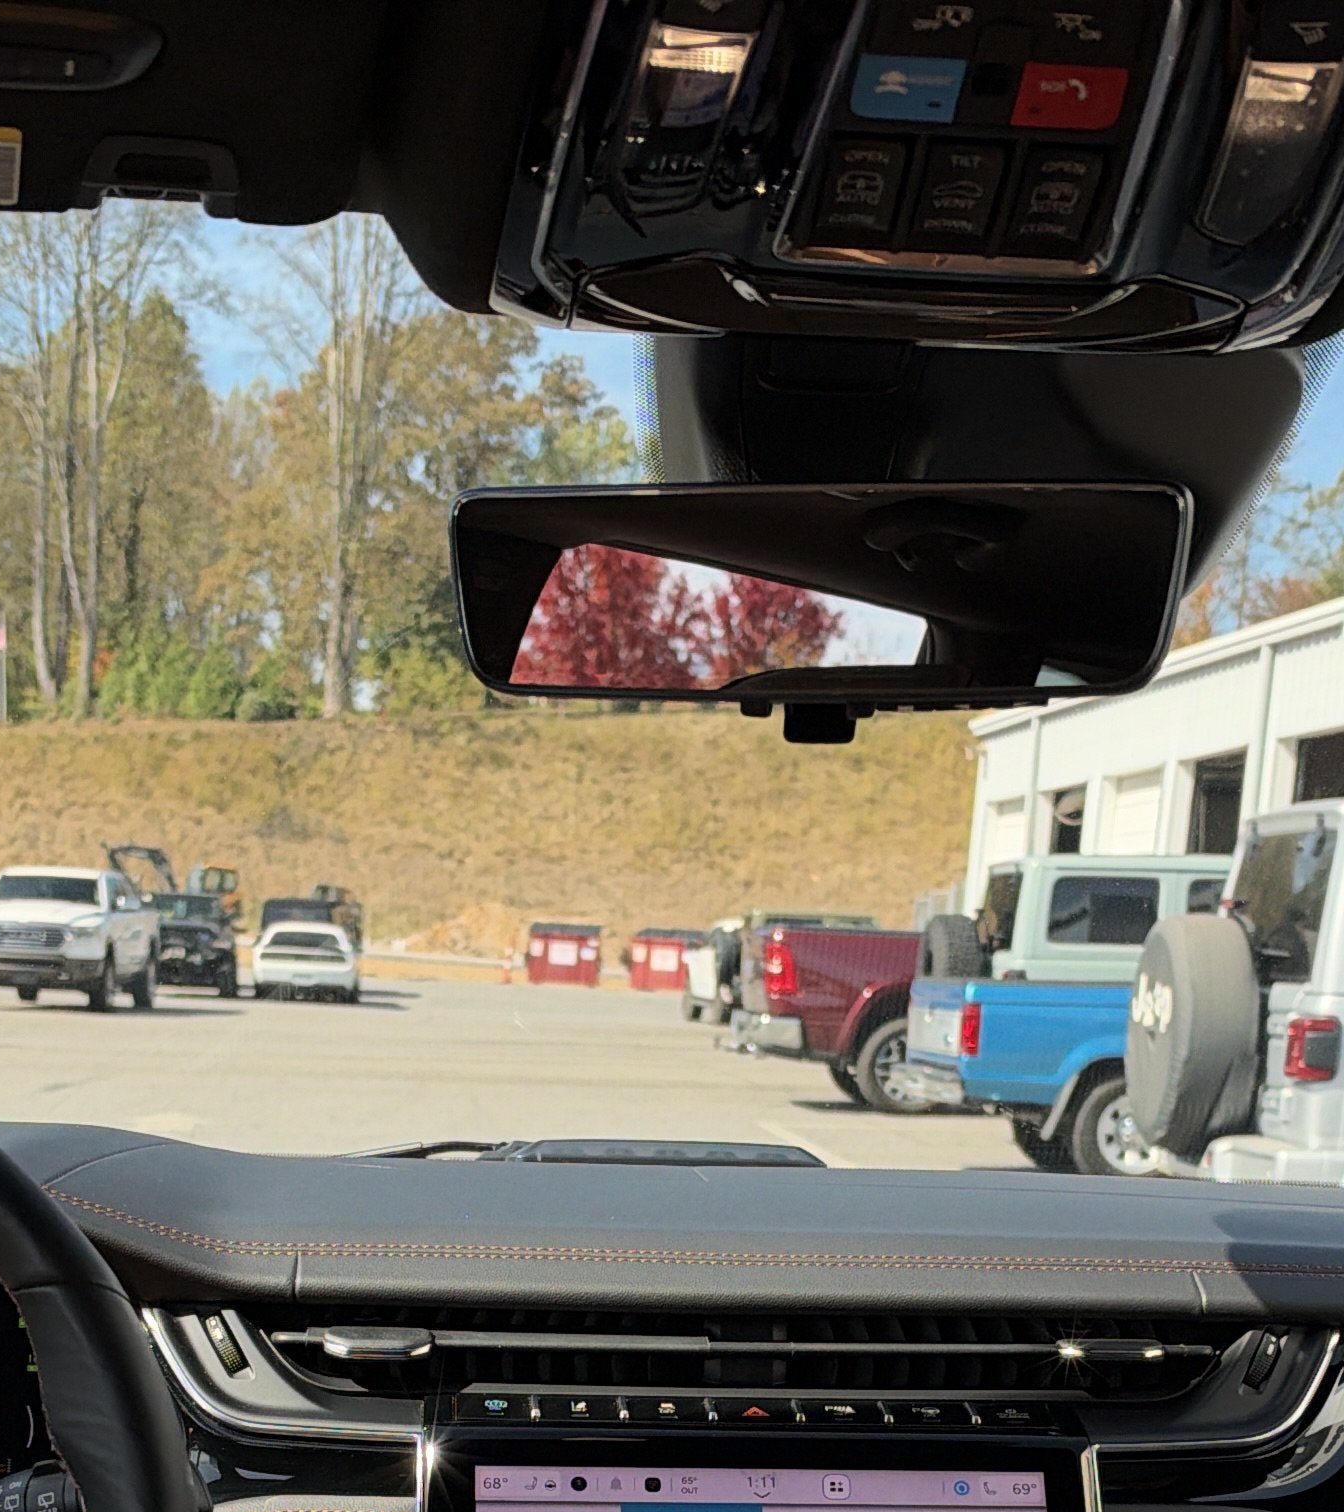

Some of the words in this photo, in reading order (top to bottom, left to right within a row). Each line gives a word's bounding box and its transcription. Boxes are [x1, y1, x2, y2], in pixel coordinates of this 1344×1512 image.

[9, 1481, 22, 1490] ON
[746, 1475, 777, 1488] 1:11
[681, 1486, 699, 1495] OUT
